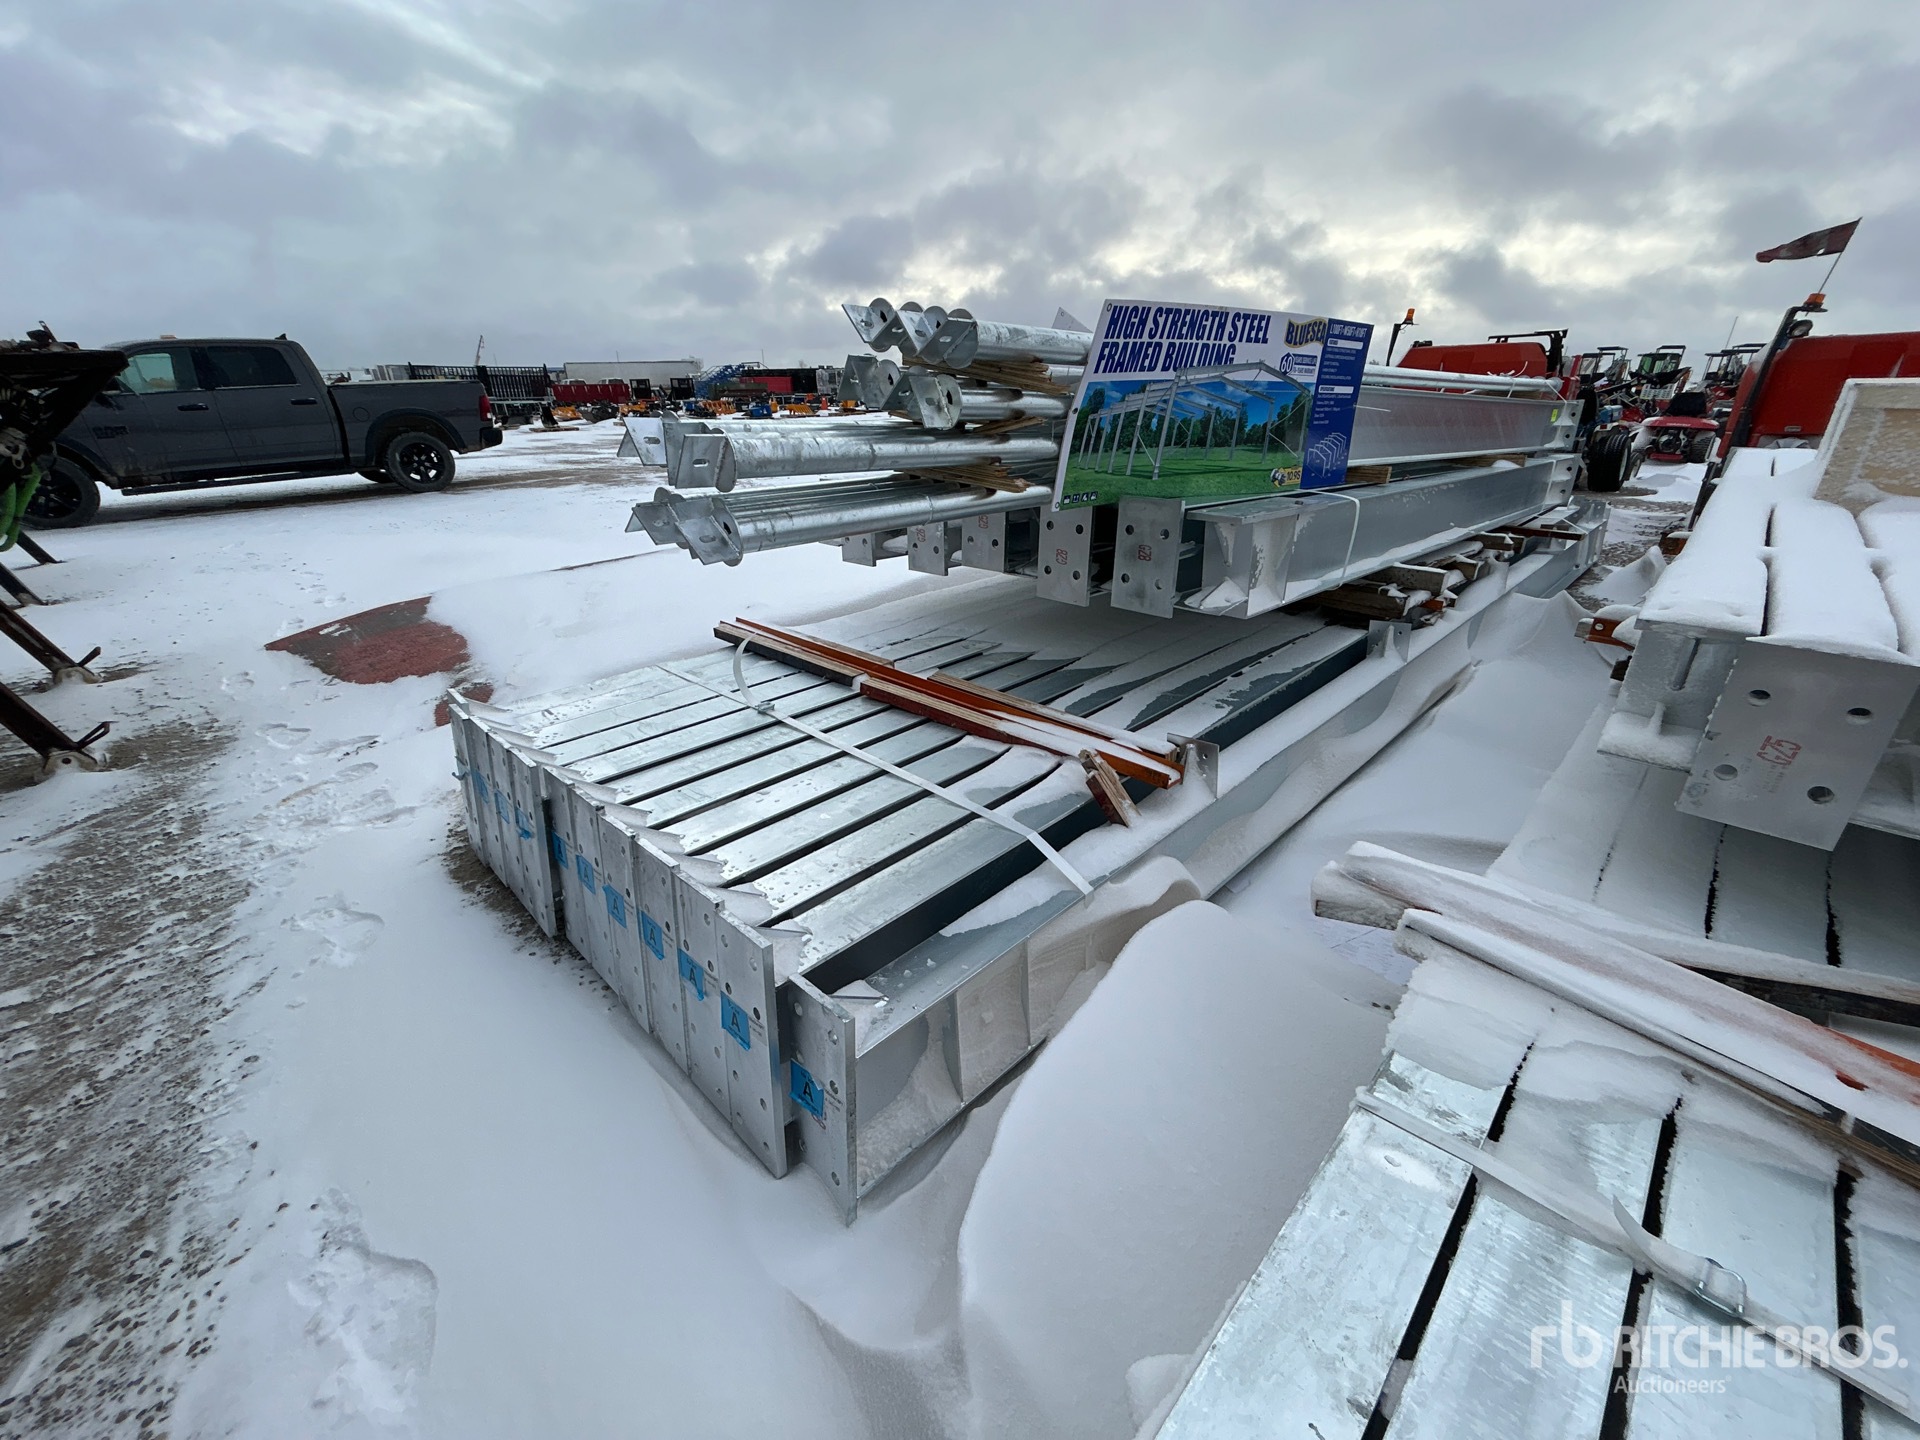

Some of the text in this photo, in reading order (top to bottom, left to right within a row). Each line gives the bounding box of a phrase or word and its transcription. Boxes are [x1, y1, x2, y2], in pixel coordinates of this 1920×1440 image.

[1104, 305, 1272, 344] HIGH STRENGTH STEEL
[1285, 320, 1327, 346] BLUESEA
[1093, 341, 1237, 374] FRAMED BUILDING
[1280, 356, 1293, 372] 60
[1056, 548, 1068, 566] GZ8
[1138, 544, 1152, 561] GZ8
[1756, 735, 1802, 765] GZ5
[613, 898, 620, 914] A
[649, 928, 657, 945] A
[690, 967, 698, 988] A
[731, 1011, 741, 1033] A
[803, 1080, 815, 1104] A
